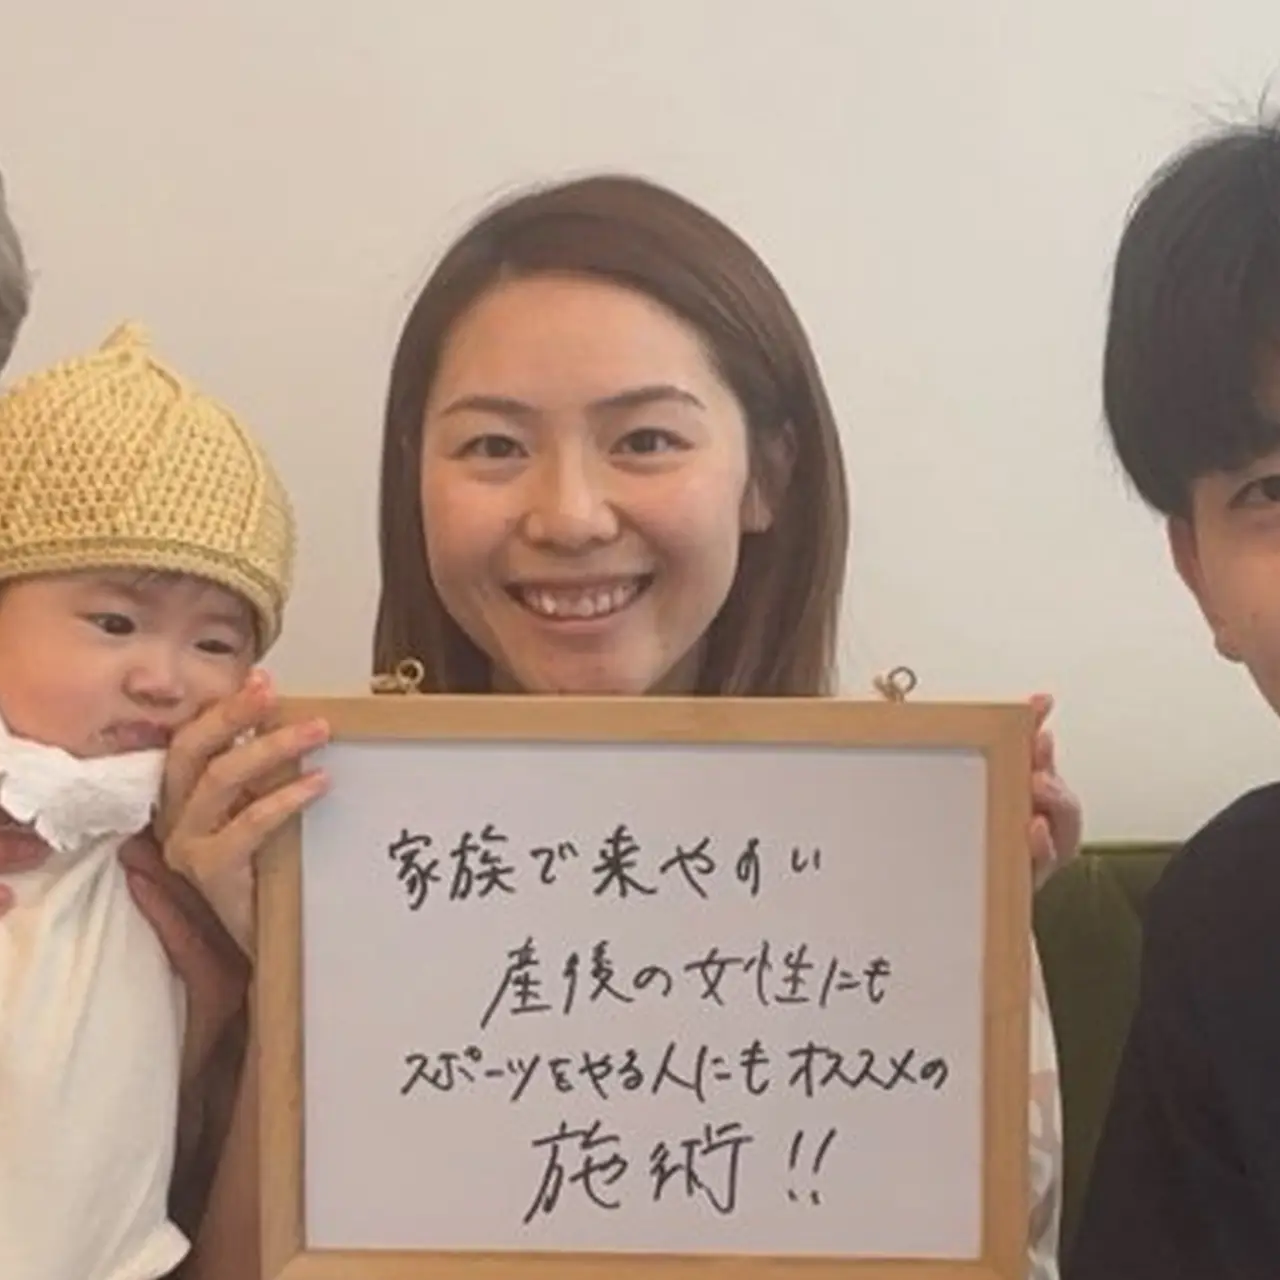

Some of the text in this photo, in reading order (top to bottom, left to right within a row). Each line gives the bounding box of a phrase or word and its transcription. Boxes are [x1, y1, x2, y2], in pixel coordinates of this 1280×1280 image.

[480, 936, 891, 1029] 産後の女性にも
